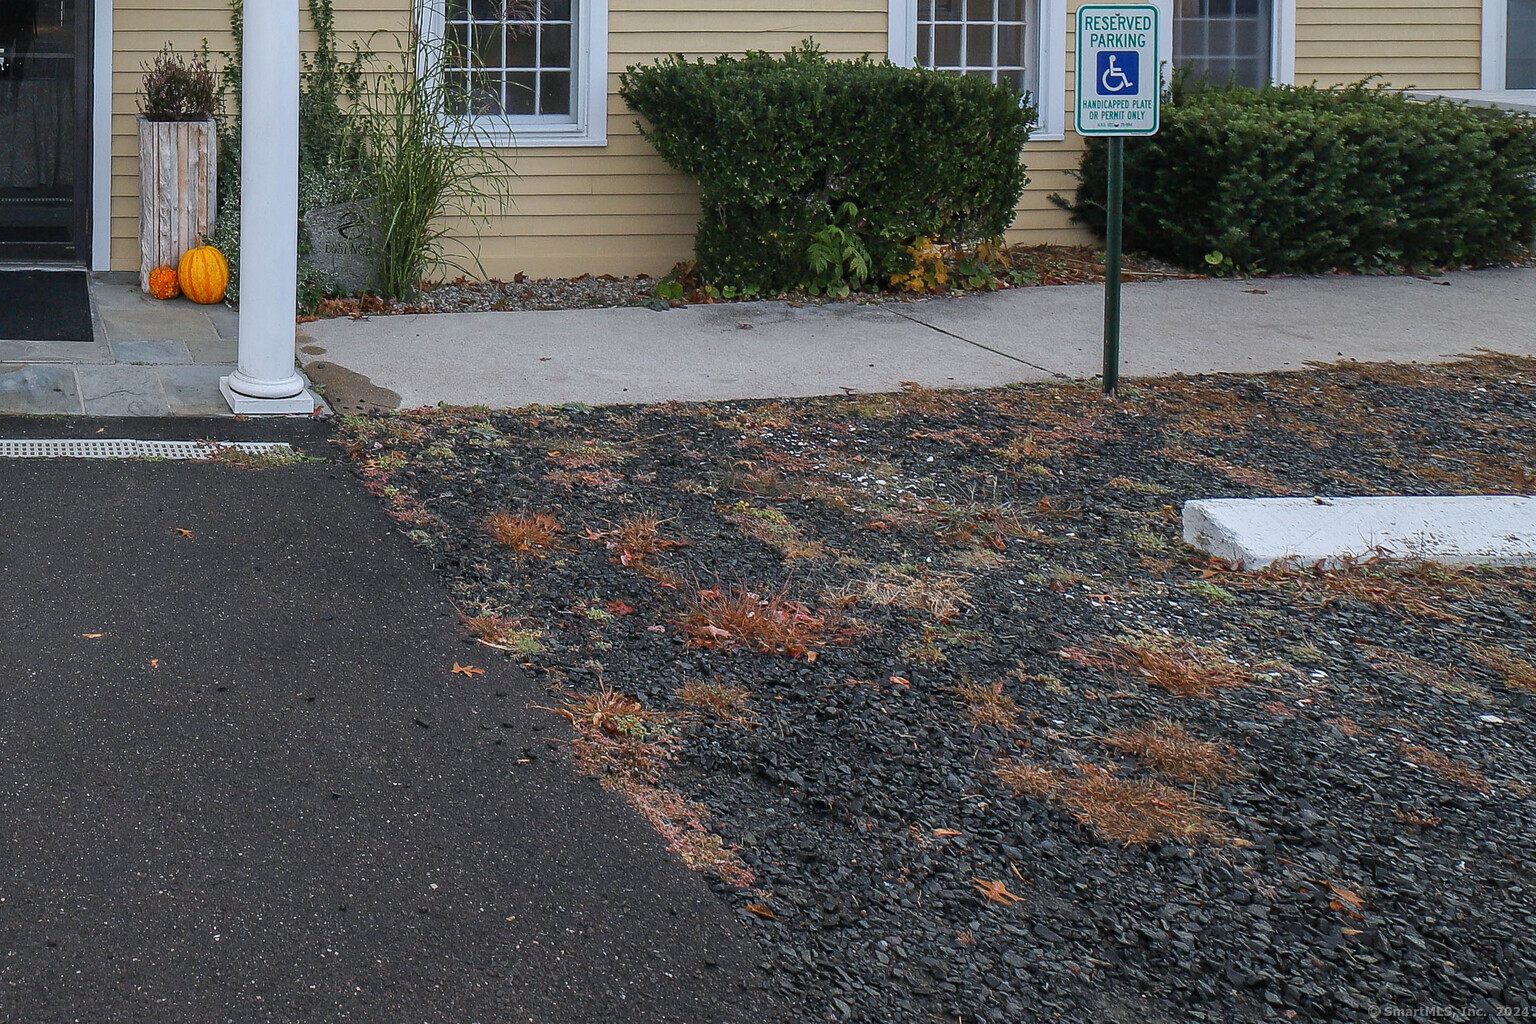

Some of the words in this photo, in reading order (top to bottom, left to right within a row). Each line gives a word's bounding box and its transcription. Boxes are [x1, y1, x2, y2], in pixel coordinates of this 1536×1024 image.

[1085, 16, 1151, 31] RESERVED
[1090, 34, 1146, 48] PARKING
[1083, 100, 1129, 109] HANDICAPPED
[1132, 100, 1152, 109] PLATE
[1089, 110, 1099, 120] OR
[1101, 110, 1125, 120] PERMIT
[1127, 110, 1146, 120] ONLY
